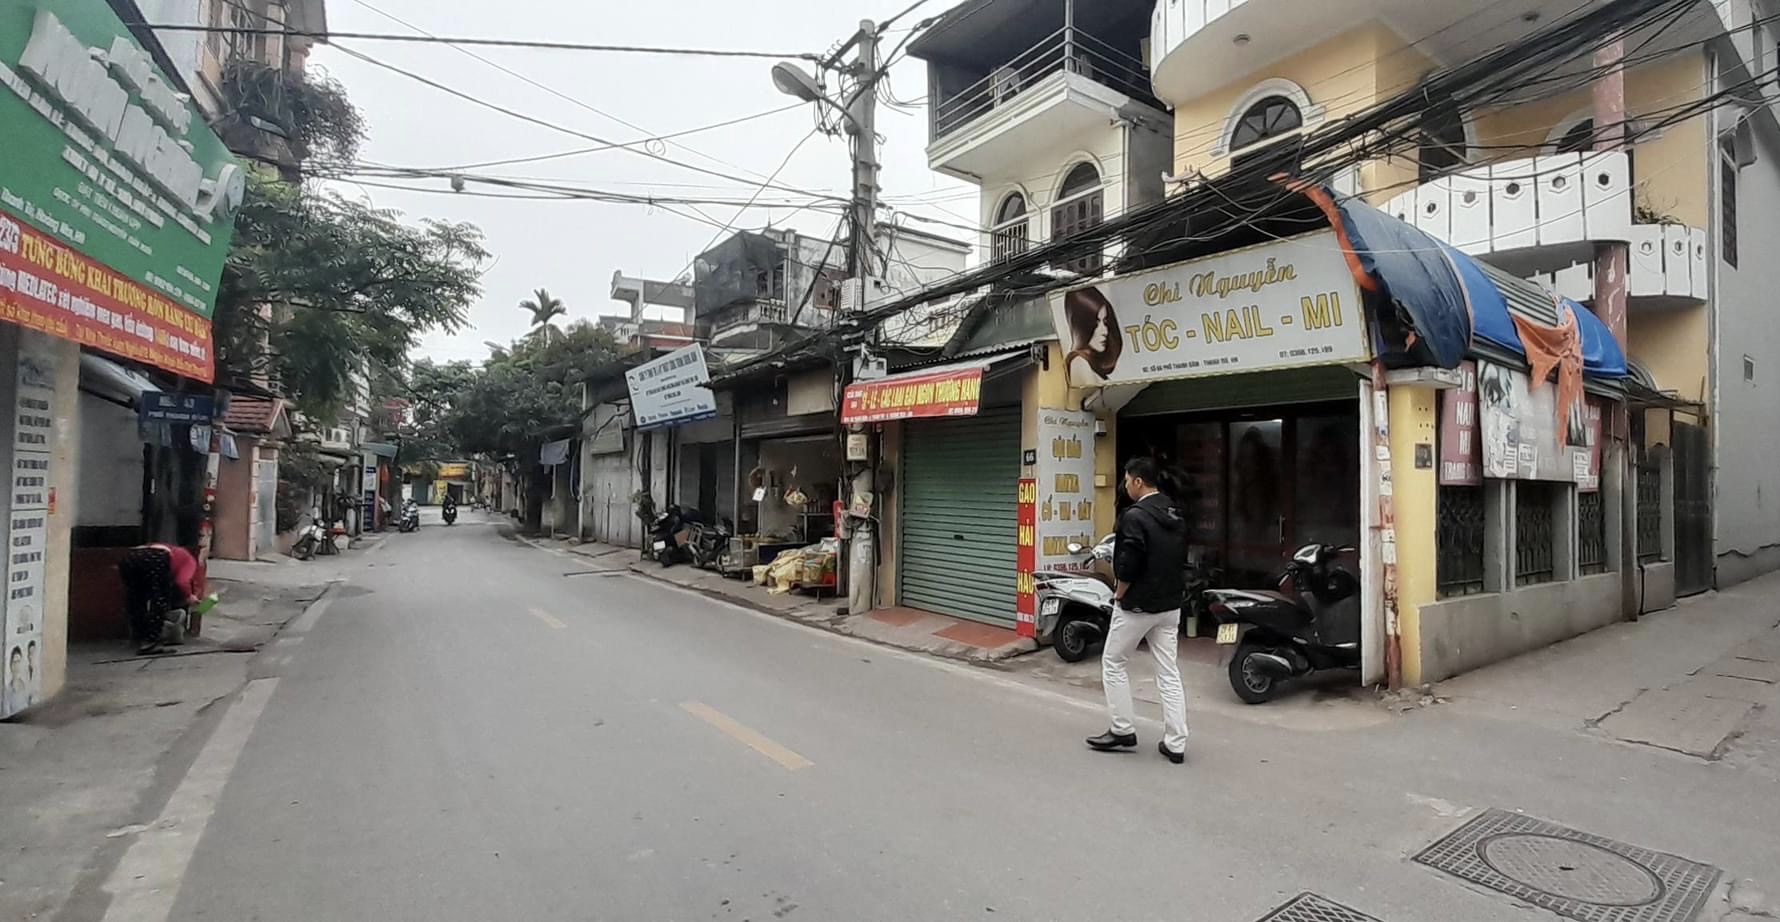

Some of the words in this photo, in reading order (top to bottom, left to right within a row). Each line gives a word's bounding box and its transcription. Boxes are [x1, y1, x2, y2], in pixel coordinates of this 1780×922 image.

[86, 263, 113, 296] KHAI
[1189, 257, 1298, 298] Nguyễn
[1125, 315, 1180, 354] TÓC
[1201, 304, 1274, 345] NAIL
[1300, 291, 1344, 331] MI
[1018, 481, 1036, 508] GẠO
[1018, 517, 1034, 546] HẢI
[1017, 568, 1036, 599] HẬU
